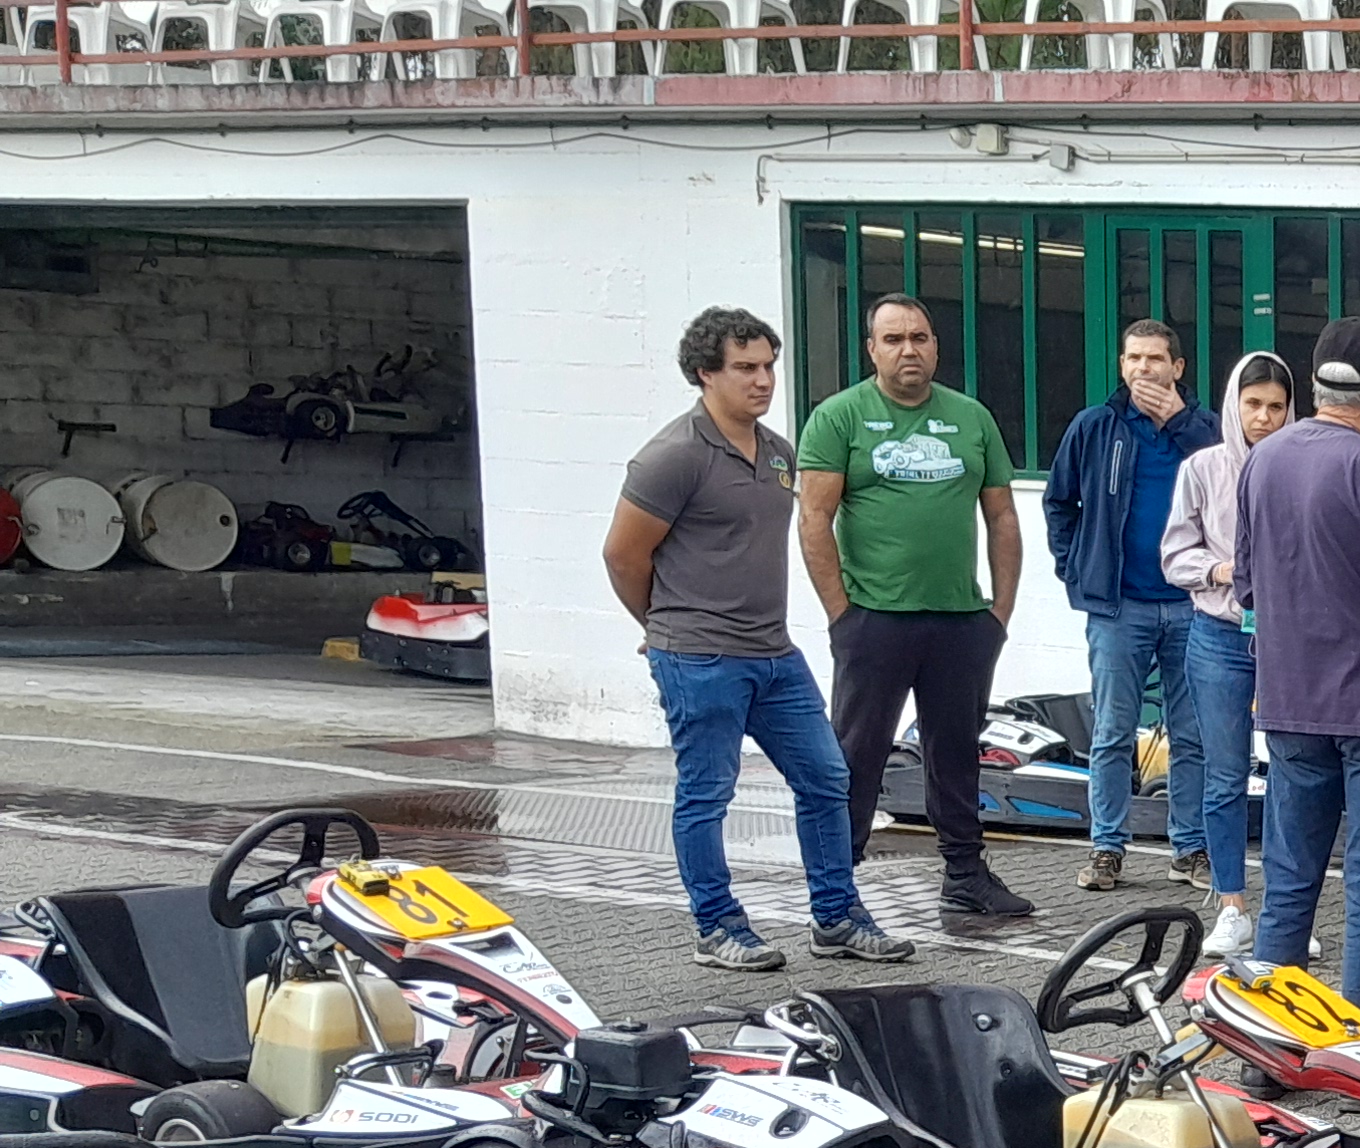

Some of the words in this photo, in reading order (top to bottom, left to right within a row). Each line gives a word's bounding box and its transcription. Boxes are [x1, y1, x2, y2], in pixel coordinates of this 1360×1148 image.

[388, 879, 470, 925] 81
[1261, 980, 1360, 1033] 82
[358, 1111, 419, 1124] SODI
